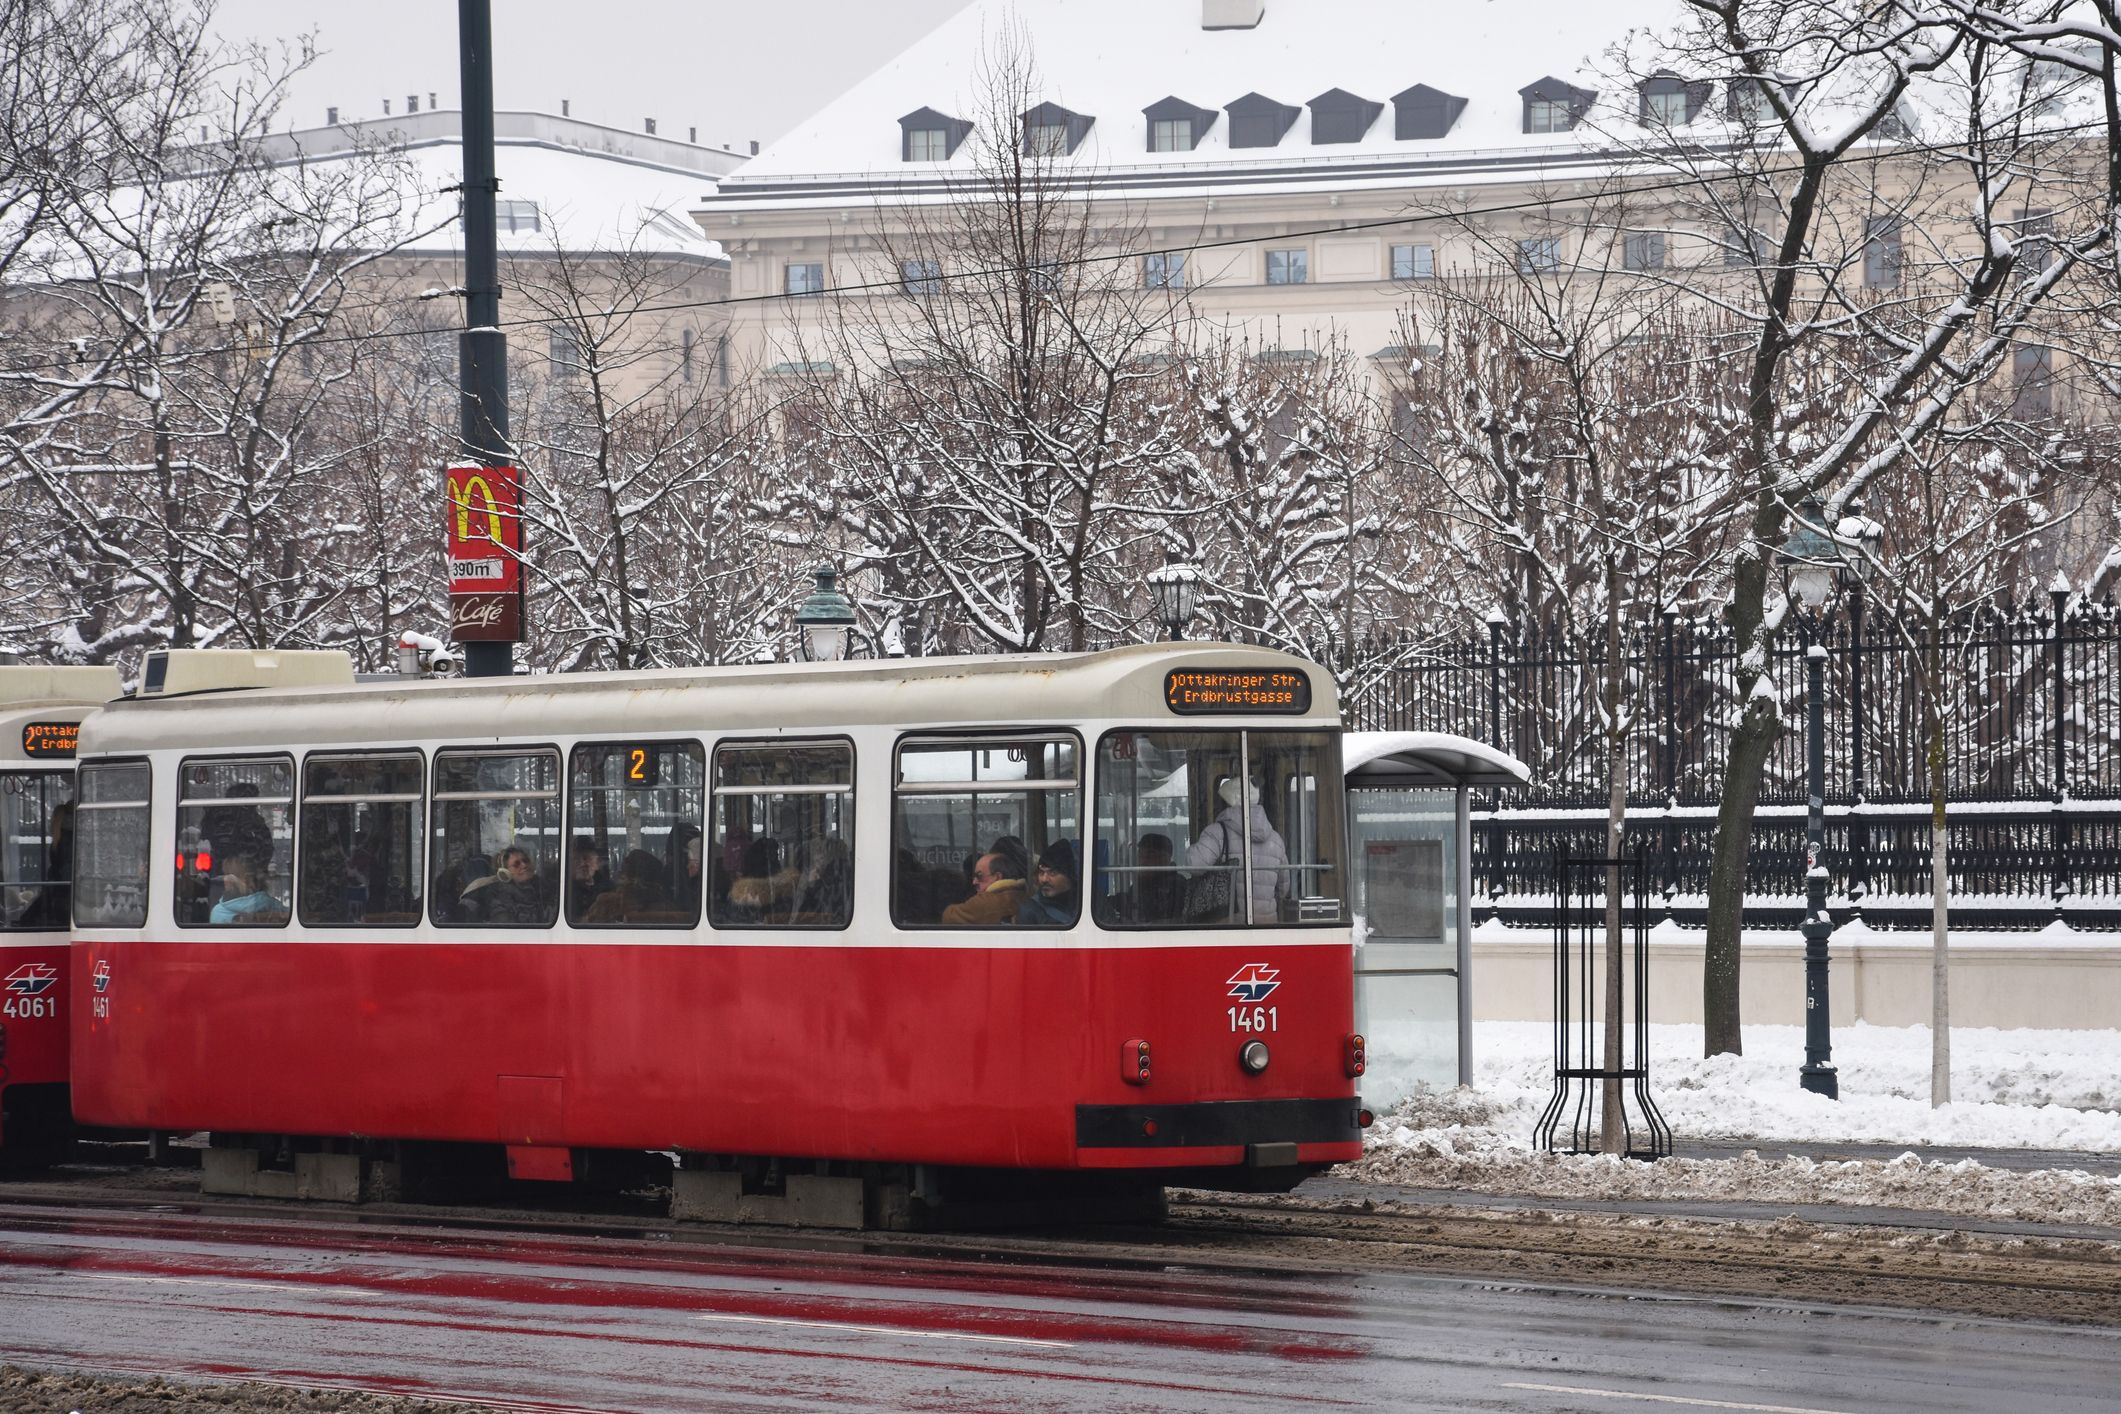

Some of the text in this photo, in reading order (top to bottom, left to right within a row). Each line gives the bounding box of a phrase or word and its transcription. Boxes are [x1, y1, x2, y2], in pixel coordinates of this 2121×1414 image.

[453, 562, 490, 577] 390m
[1178, 674, 1302, 688] Ottakringer Str.
[1185, 690, 1293, 704] Erdbrustgasse
[631, 749, 645, 779] 2
[3, 996, 55, 1018] 4061
[93, 996, 109, 1018] 1461
[1227, 1006, 1277, 1032] 1461
